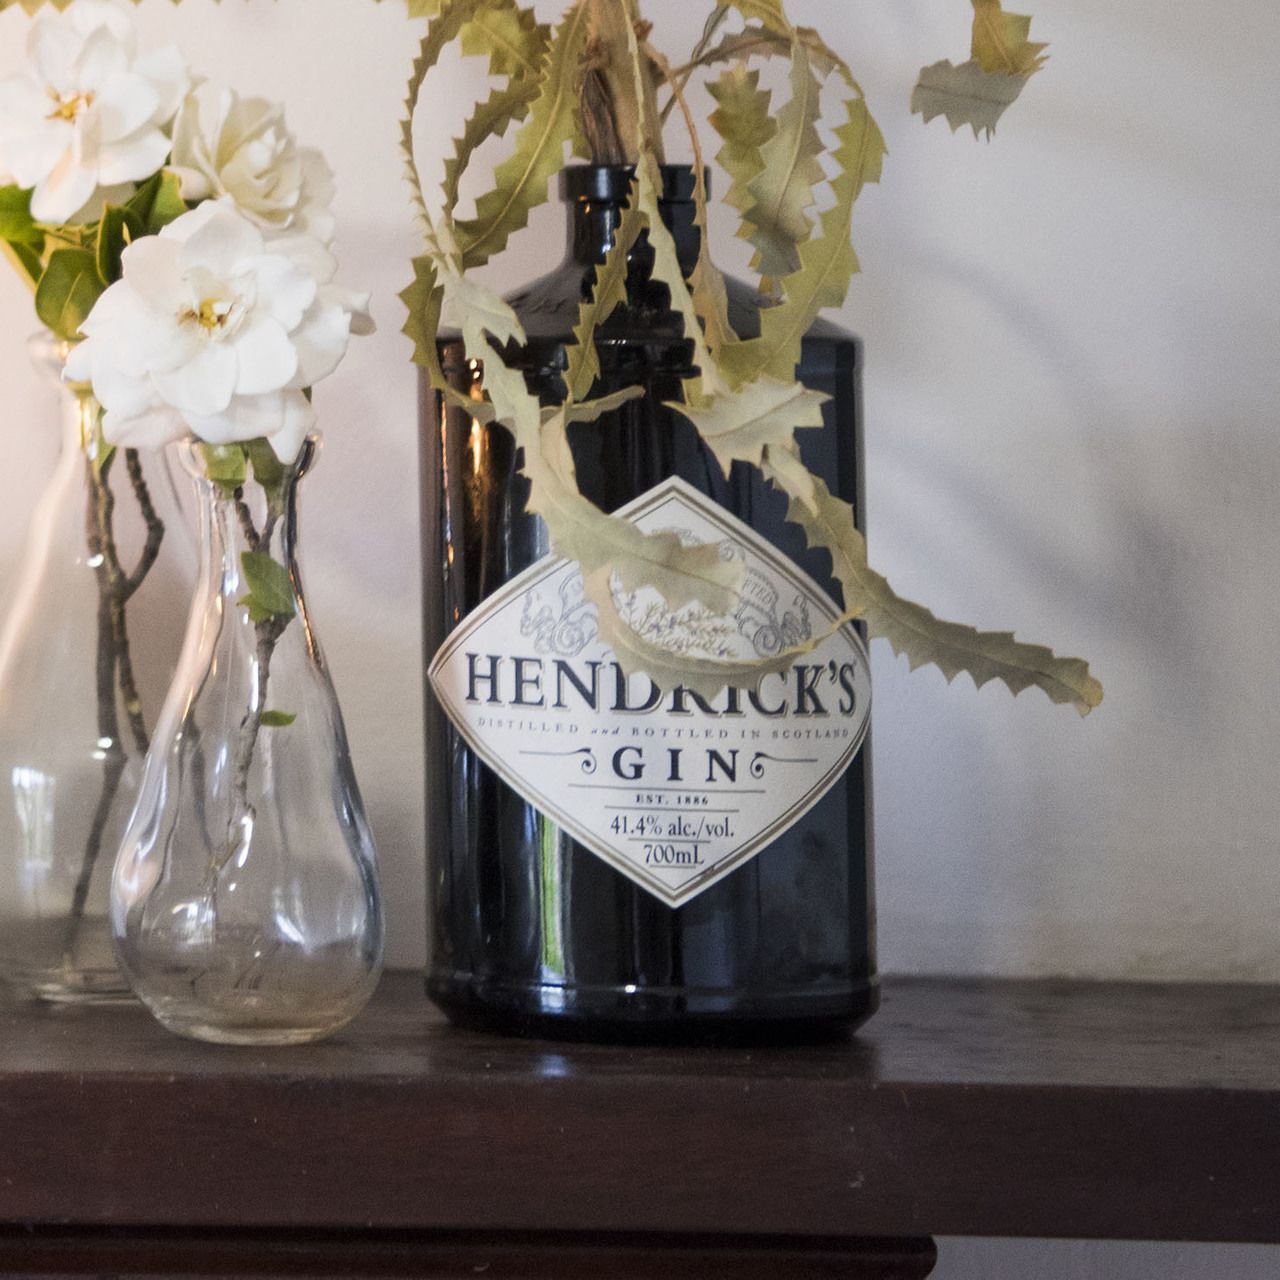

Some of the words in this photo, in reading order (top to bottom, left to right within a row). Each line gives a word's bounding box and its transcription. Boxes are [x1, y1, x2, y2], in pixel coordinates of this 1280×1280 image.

[477, 717, 579, 734] DISTILLED
[591, 727, 621, 735] and
[631, 726, 728, 739] BOTTLED
[740, 728, 761, 739] IN
[771, 728, 850, 740] SCOTLAND
[611, 746, 739, 783] GIN
[635, 794, 669, 805] EST.
[610, 815, 663, 836] 41.4%
[667, 815, 735, 840] alc./vol.
[643, 844, 705, 865] 700mL
